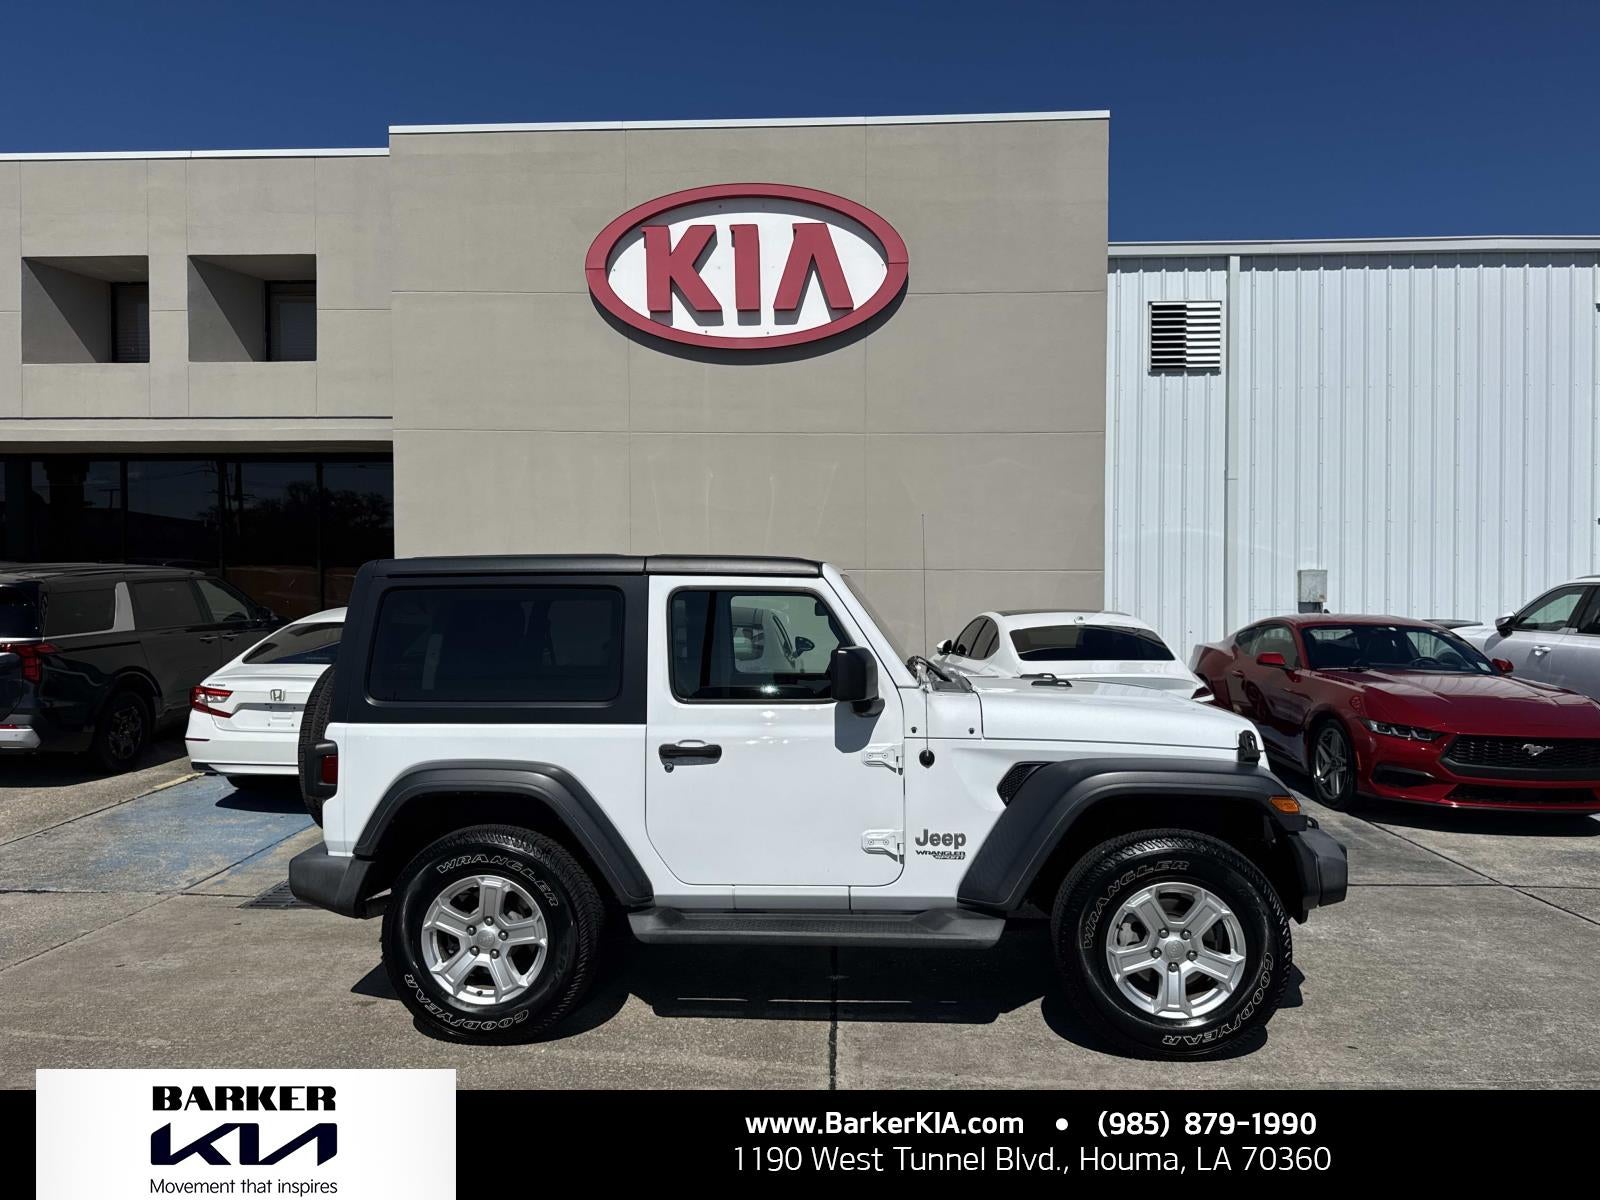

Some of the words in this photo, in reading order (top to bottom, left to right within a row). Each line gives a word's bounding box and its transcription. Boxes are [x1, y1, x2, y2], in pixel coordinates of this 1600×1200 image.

[640, 223, 854, 312] KIA
[914, 829, 966, 849] Jeep
[436, 853, 559, 907] WRANGLER
[1083, 860, 1190, 950] WRANGLER
[403, 973, 530, 1031] GOODYEAR
[1162, 952, 1275, 1046] GOODYEAR
